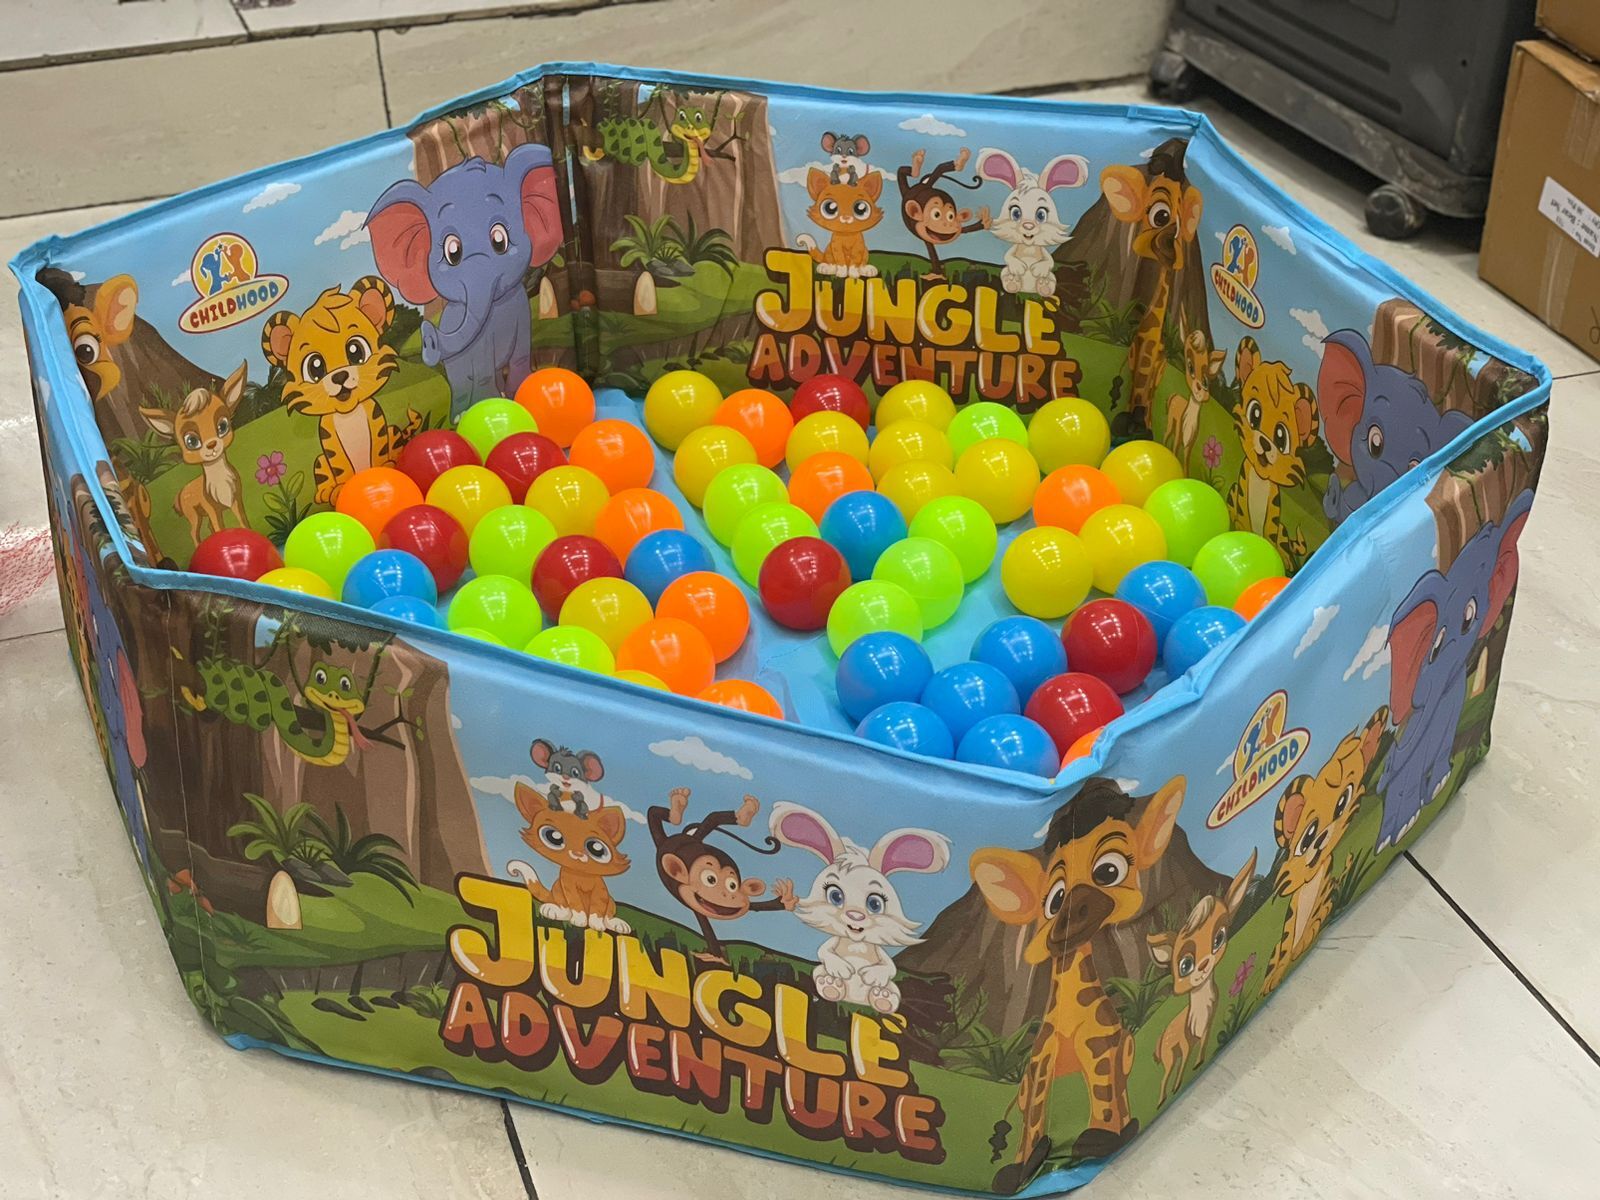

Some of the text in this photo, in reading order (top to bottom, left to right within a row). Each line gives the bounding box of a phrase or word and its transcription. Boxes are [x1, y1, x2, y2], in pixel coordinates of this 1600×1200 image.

[189, 280, 279, 329] CHILDHOOD
[754, 249, 1061, 356] JUNGLE
[1213, 269, 1260, 324] CHILDHOOD
[749, 332, 1080, 402] ADVENTURE
[1216, 737, 1300, 822] CHILDHOOD
[449, 875, 911, 1089] JUNGLE
[441, 981, 938, 1151] ADVENTURE
